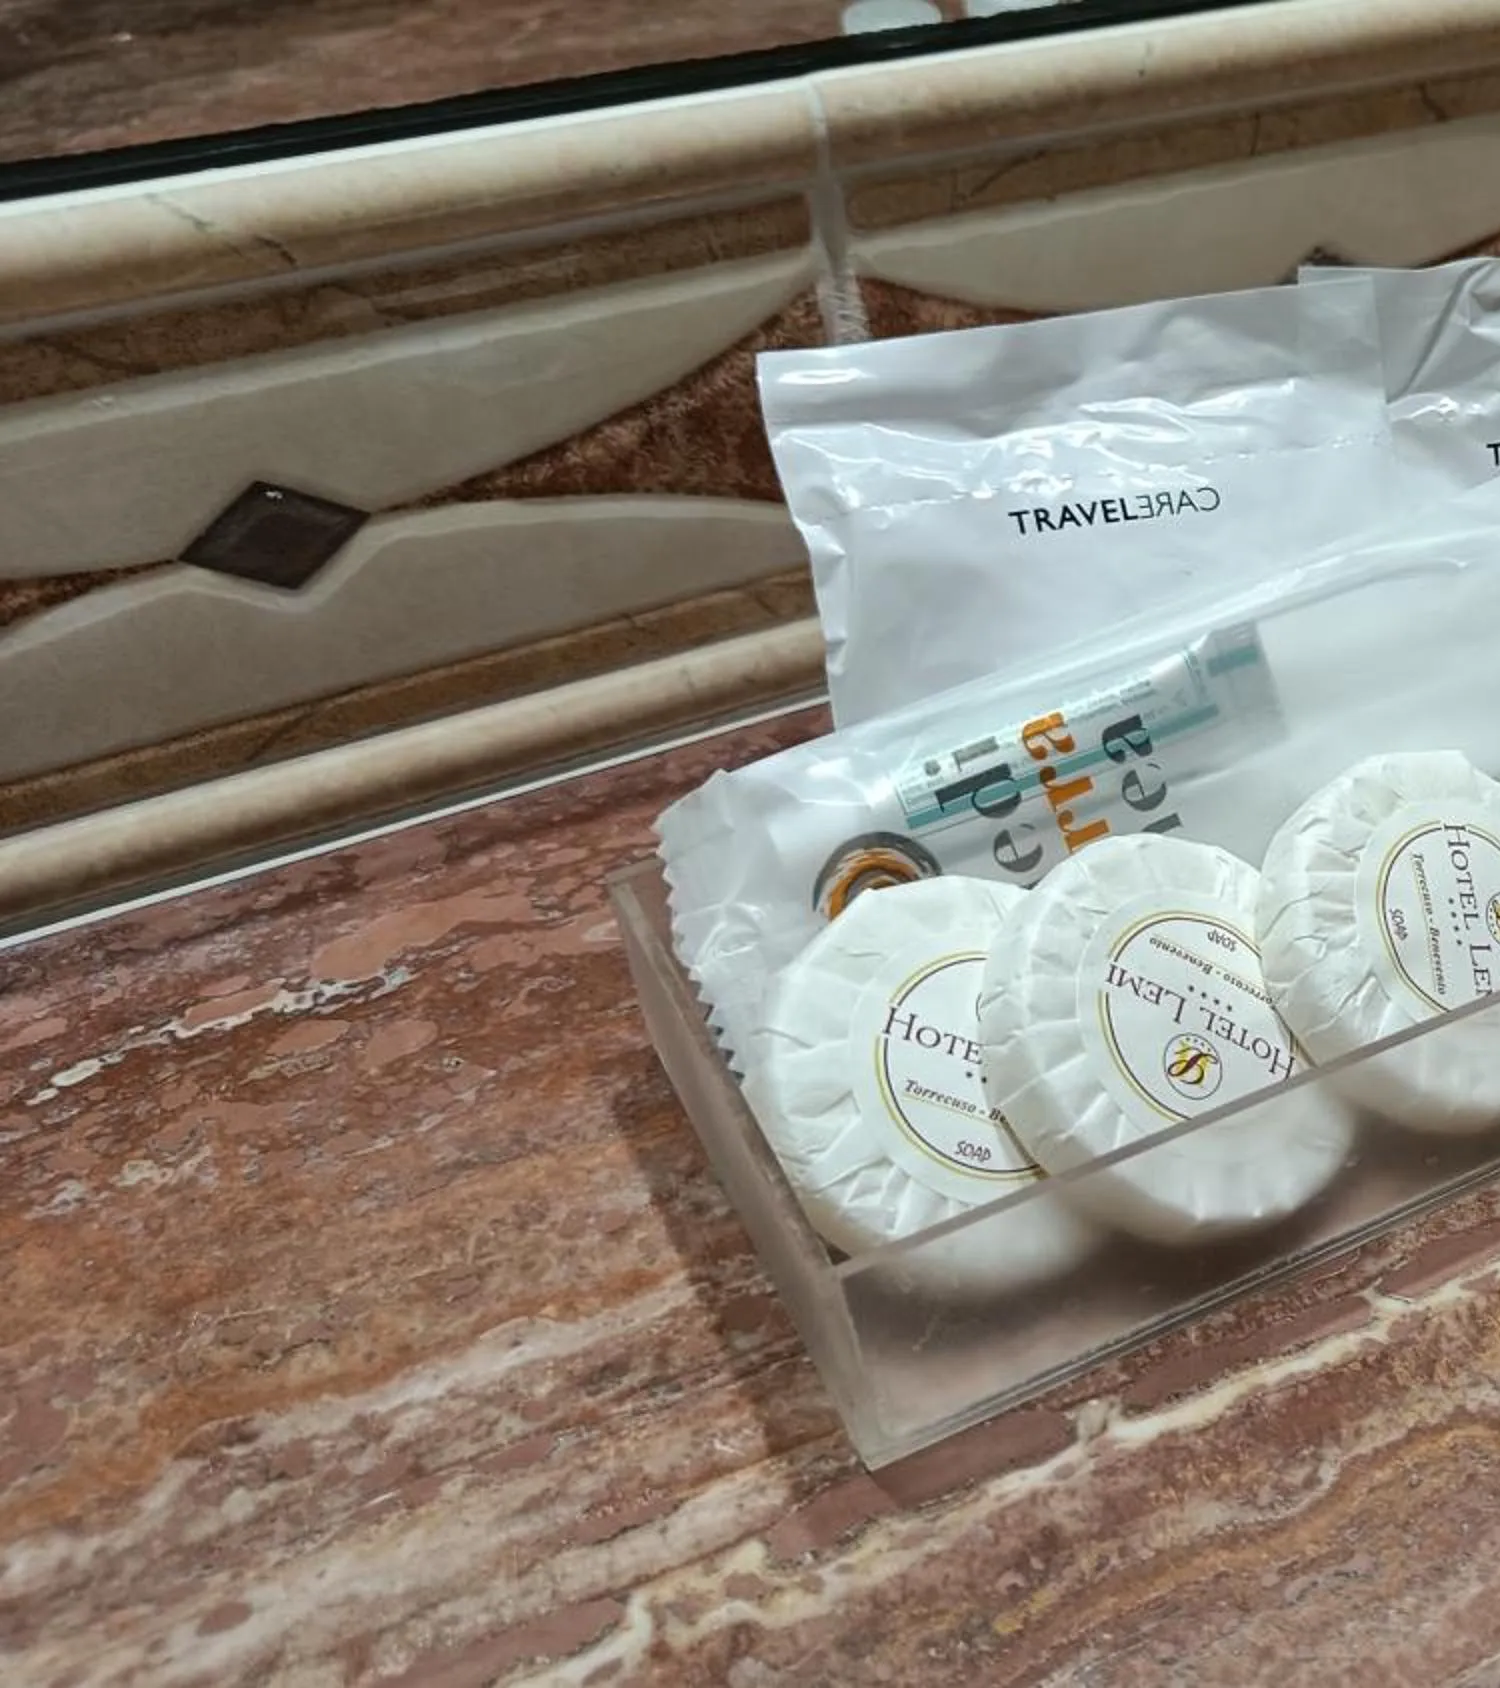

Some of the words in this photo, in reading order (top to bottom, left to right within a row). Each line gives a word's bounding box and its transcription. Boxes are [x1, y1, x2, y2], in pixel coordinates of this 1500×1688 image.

[924, 734, 1043, 889] edi
[1022, 711, 1111, 856] rra
[1443, 823, 1480, 930] HOTEL
[1469, 943, 1493, 997] LE
[1149, 936, 1214, 976] Benevento
[1206, 929, 1238, 953] SOAP
[1104, 963, 1184, 1025] LEMI
[881, 1007, 983, 1066] HOTE
[1199, 1007, 1296, 1081] HOTEL
[904, 1079, 977, 1113] Torrecuso
[953, 1139, 992, 1162] SOAP
